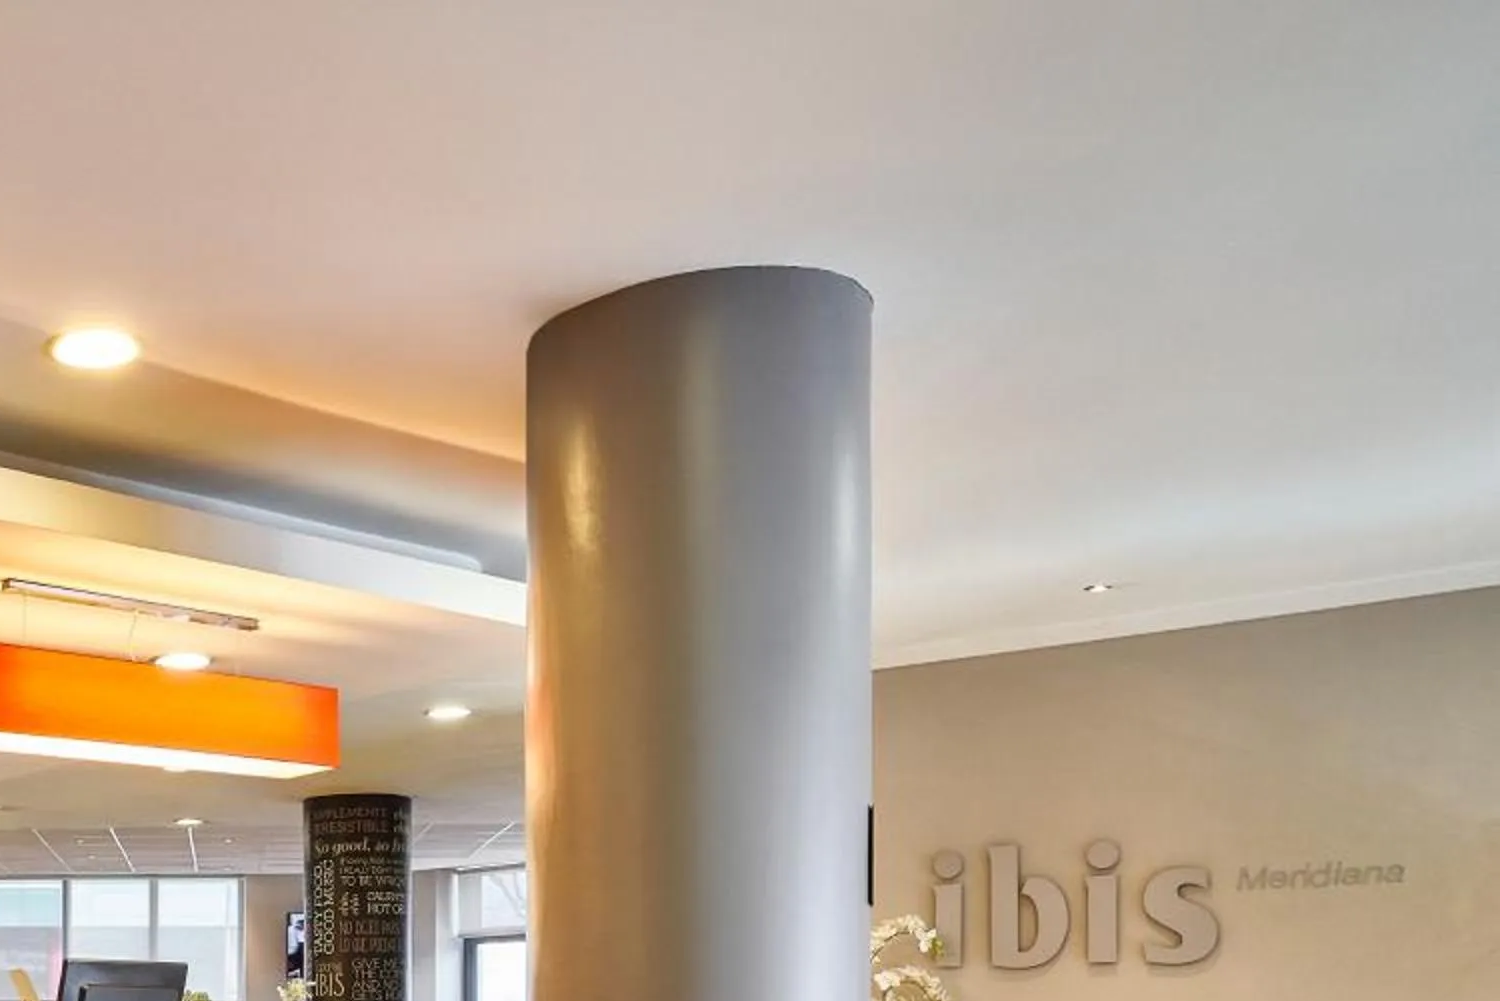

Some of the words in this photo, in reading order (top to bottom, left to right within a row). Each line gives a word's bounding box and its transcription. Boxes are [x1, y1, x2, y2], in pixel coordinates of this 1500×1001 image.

[323, 859, 335, 905] MUSIC
[930, 838, 1221, 969] ibis
[1236, 860, 1406, 892] Meridiana
[313, 912, 323, 956] TASTY
[323, 908, 335, 955] GOOD
[315, 972, 345, 997] IBIS
